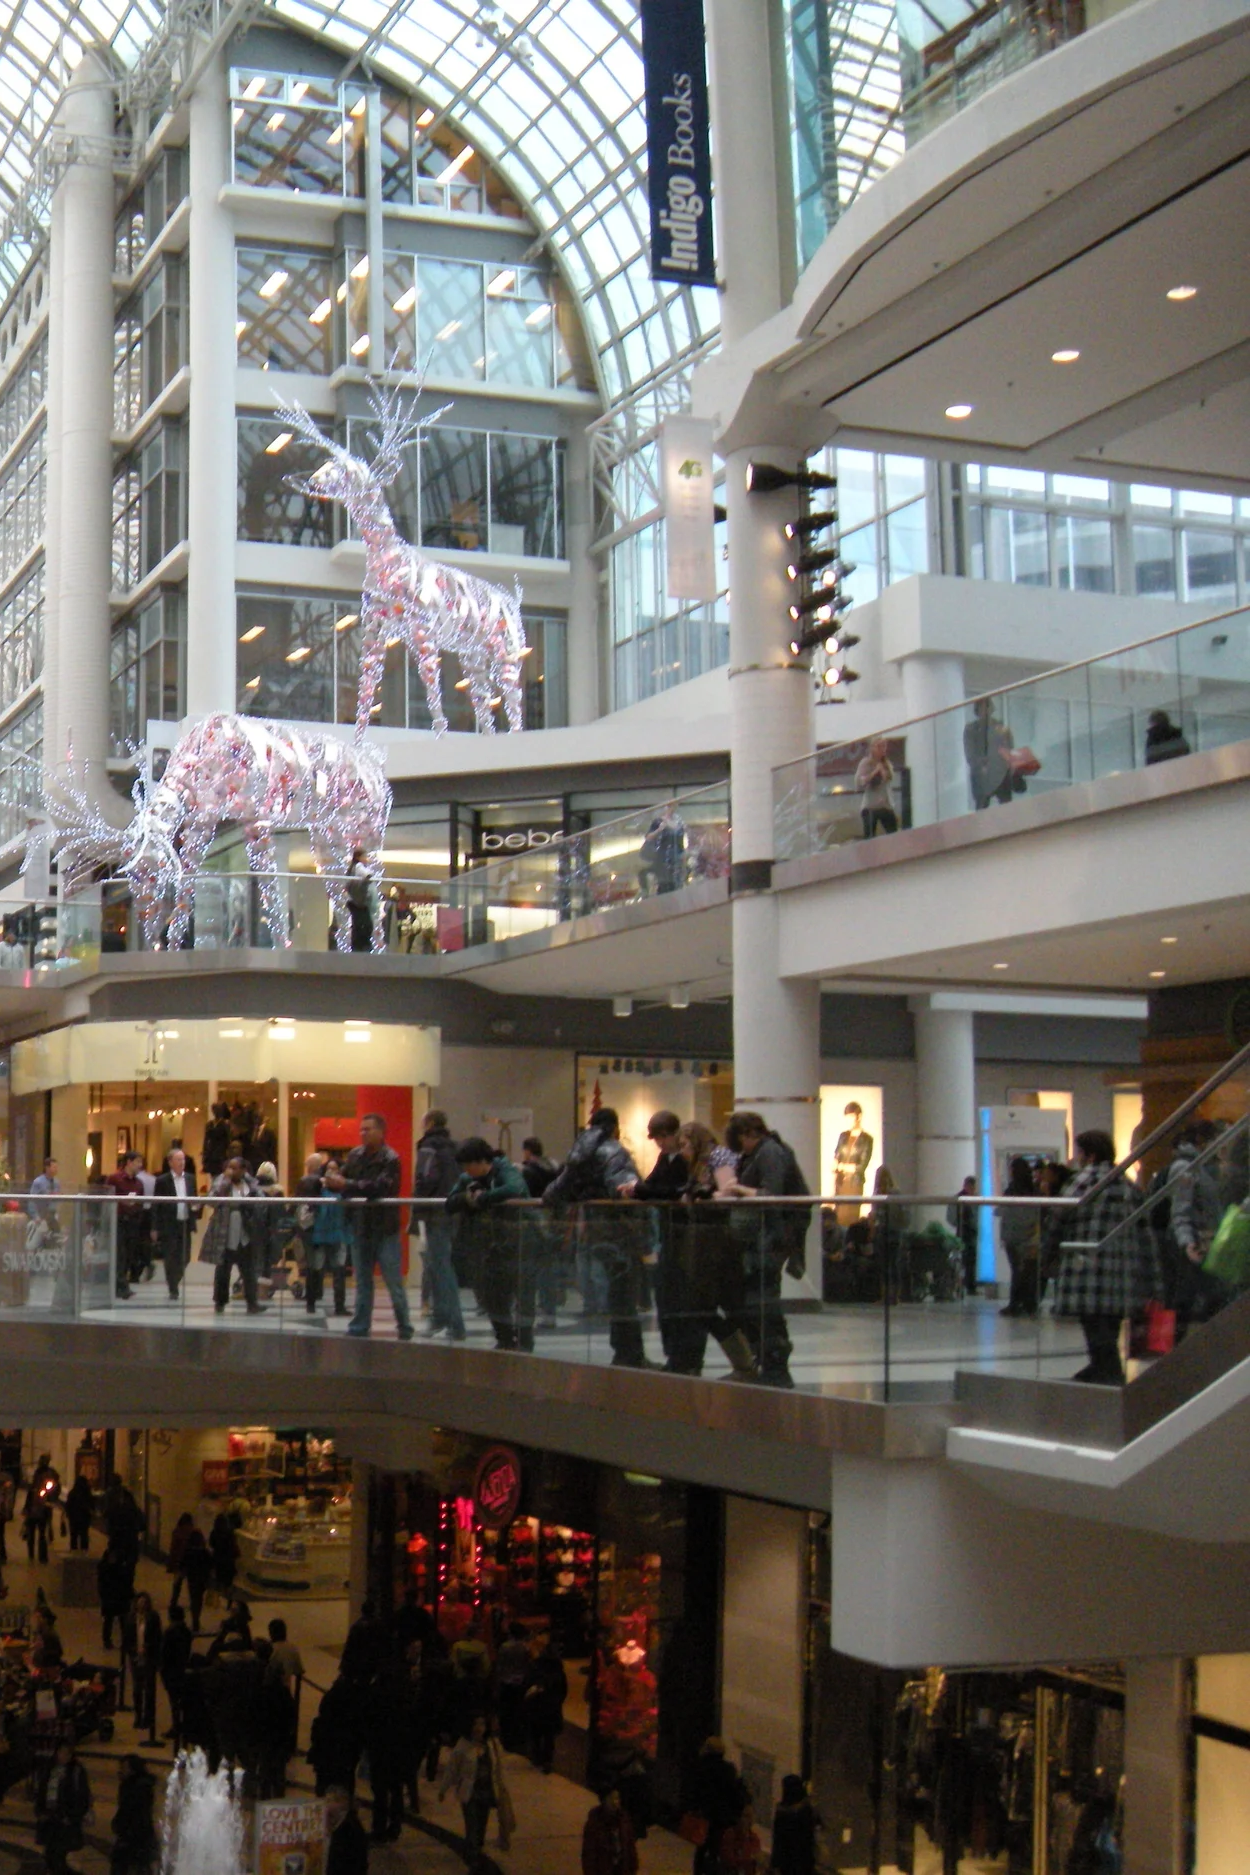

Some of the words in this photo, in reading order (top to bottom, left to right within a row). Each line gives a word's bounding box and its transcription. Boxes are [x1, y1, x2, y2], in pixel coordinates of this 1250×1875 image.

[661, 72, 695, 168] Books
[659, 175, 704, 272] Indigo
[1, 1250, 67, 1272] SWAROVSKI
[262, 1807, 298, 1819] LOVE
